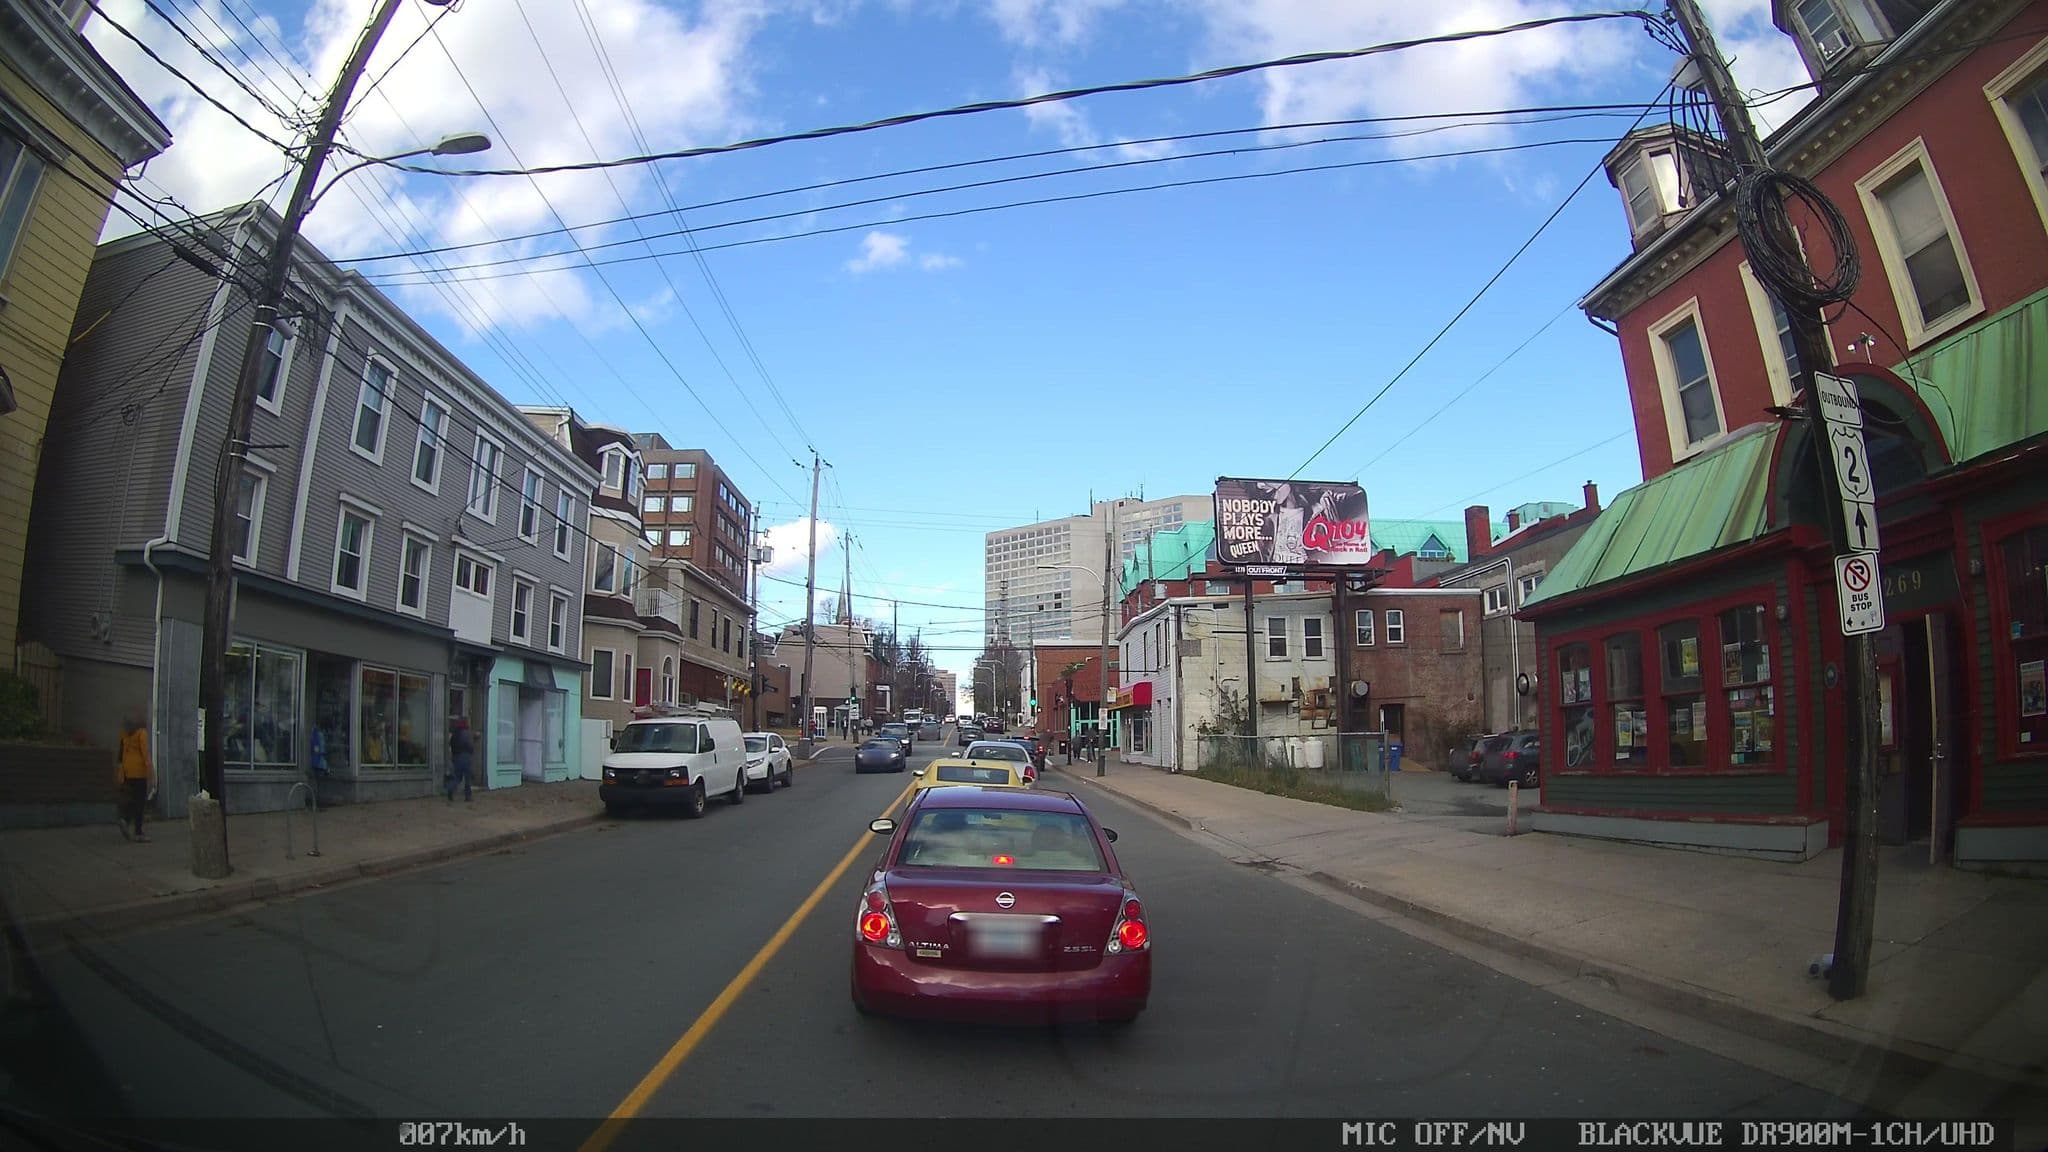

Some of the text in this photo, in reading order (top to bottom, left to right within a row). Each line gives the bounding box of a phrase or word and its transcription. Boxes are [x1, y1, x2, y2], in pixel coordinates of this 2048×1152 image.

[1821, 391, 1857, 409] OUTBOUND
[1844, 446, 1860, 483] 2
[1222, 499, 1276, 515] NOBODY
[1223, 513, 1264, 526] PLAYS
[1223, 526, 1273, 541] MORE...
[1303, 516, 1367, 552] Q104
[1229, 541, 1260, 559] QUEEN
[1248, 566, 1284, 575] OUTFRONT
[1885, 570, 1921, 597] 269
[1852, 592, 1869, 602] BUS
[1850, 601, 1872, 612] STOP
[908, 940, 950, 950] ALTIMA
